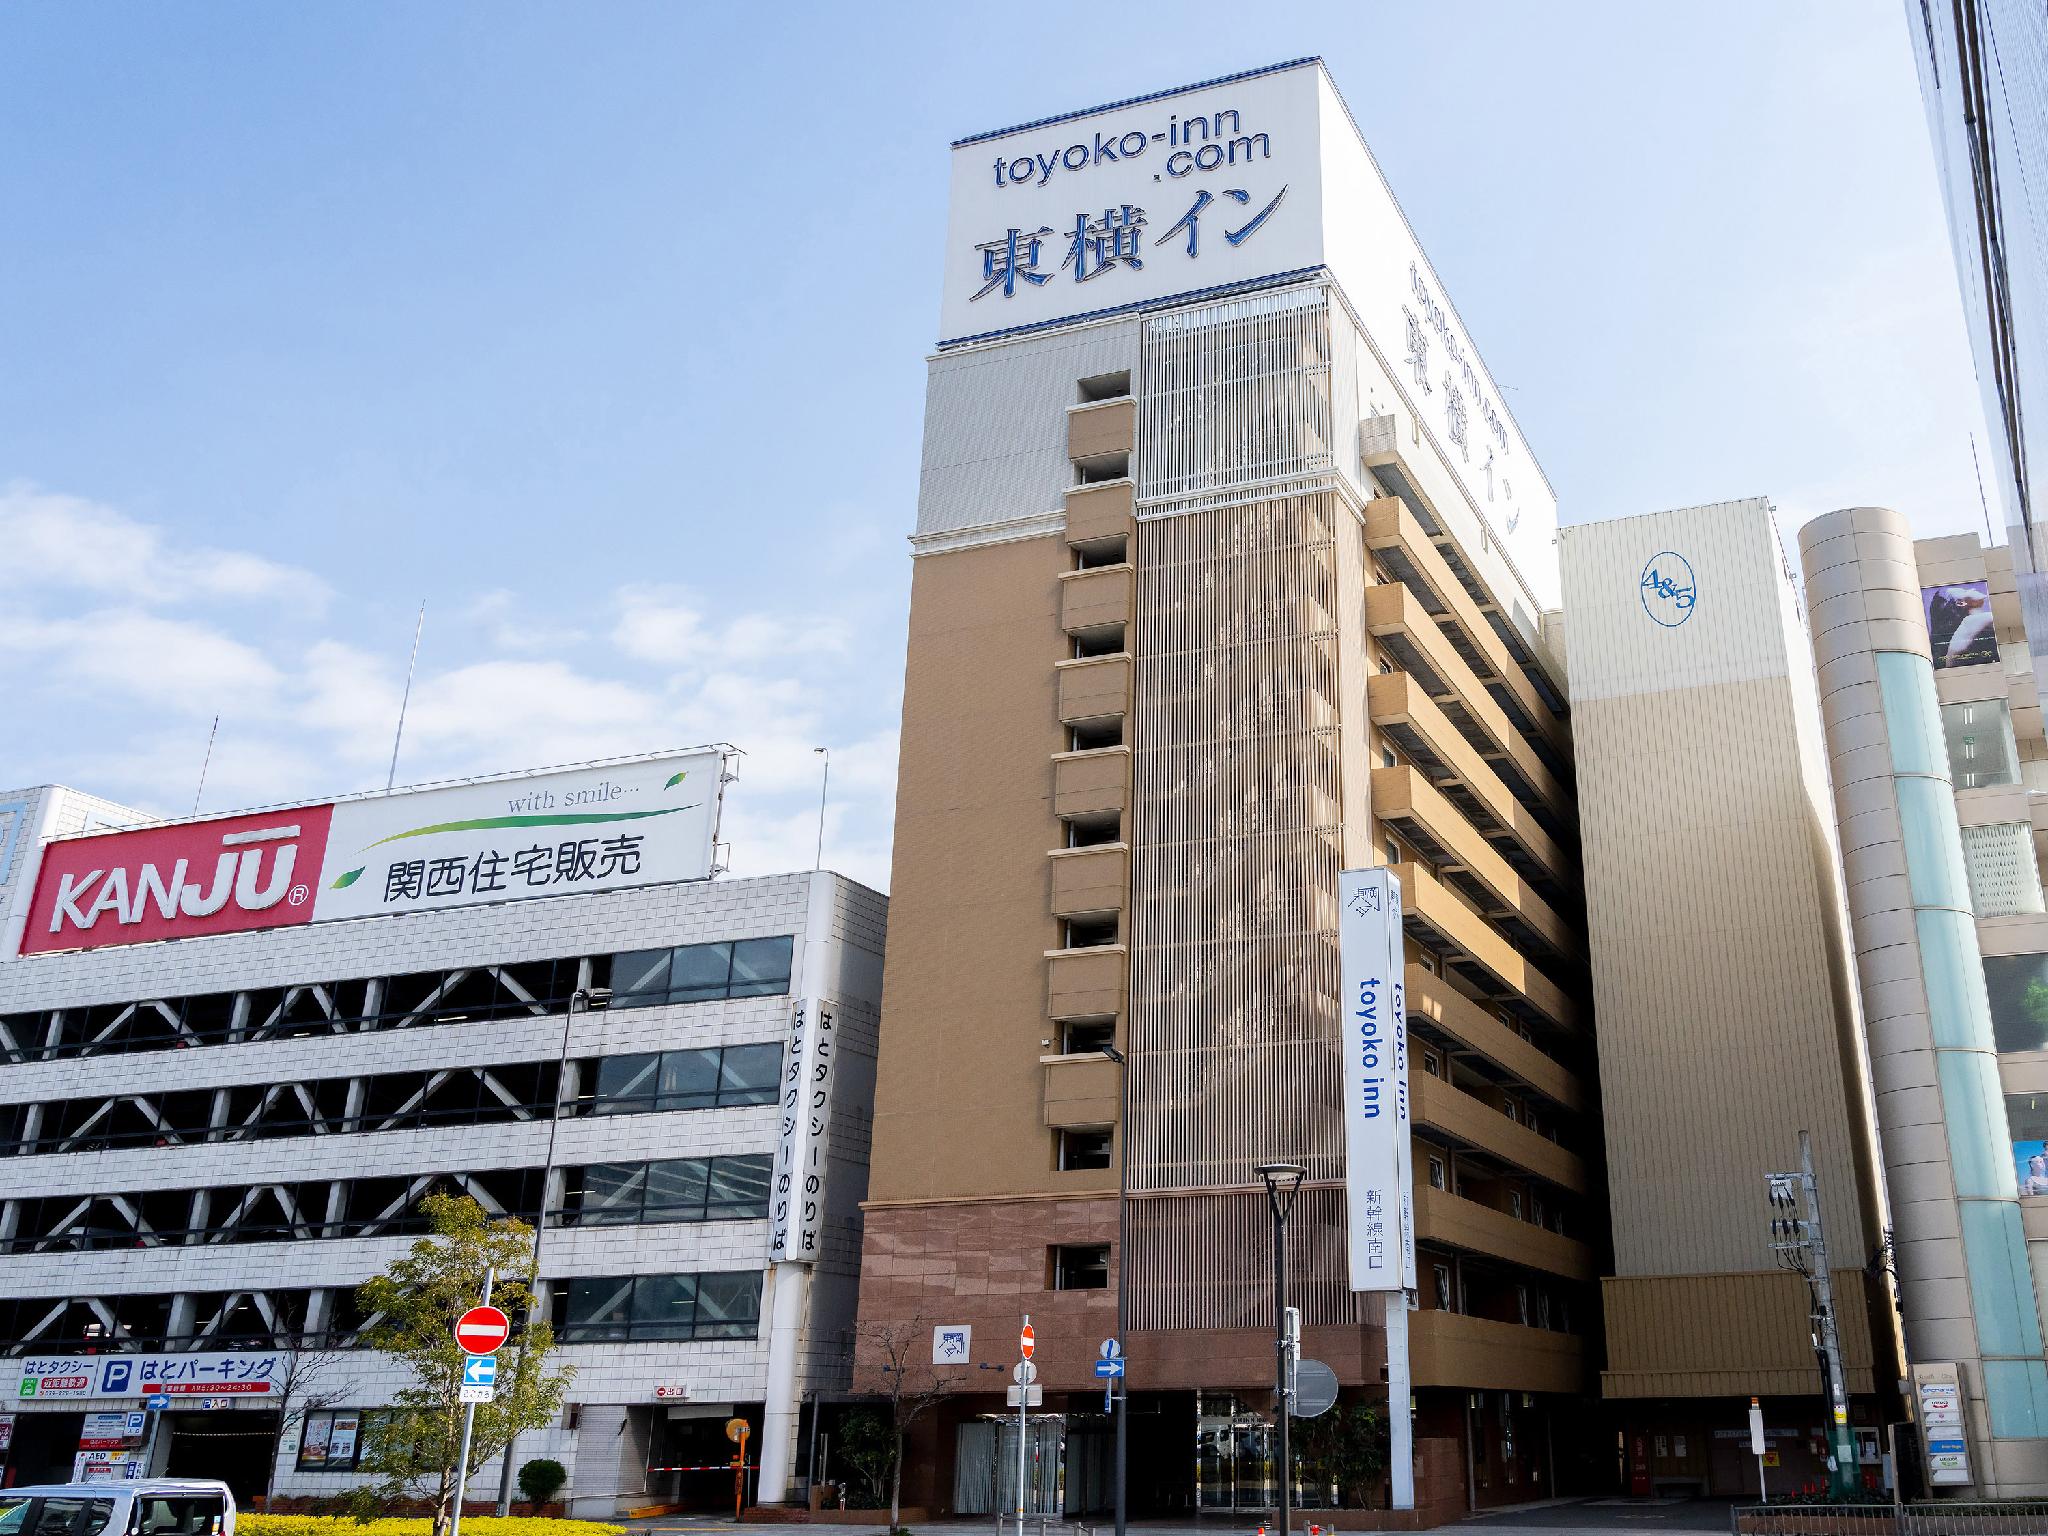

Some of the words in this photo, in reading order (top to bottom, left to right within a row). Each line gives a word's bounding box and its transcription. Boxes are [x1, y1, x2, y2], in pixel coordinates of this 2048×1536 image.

[993, 107, 1241, 188] toyoko-inn
[1153, 128, 1271, 183] .com
[969, 183, 1289, 302] 東横イン
[508, 790, 555, 813] with
[384, 833, 645, 903] 関西住宅販売
[1356, 977, 1383, 1069] toyoko
[1394, 983, 1405, 1071] toyoko
[773, 1009, 804, 1251] はとタクシーのりば
[802, 1011, 833, 1251] はとタクシーのりば
[1363, 1077, 1385, 1119] inn
[1366, 1189, 1384, 1270] 新幹線南口
[24, 1360, 94, 1375] はとタクシー
[140, 1357, 277, 1381] はとパーキング
[88, 1452, 106, 1460] AED
